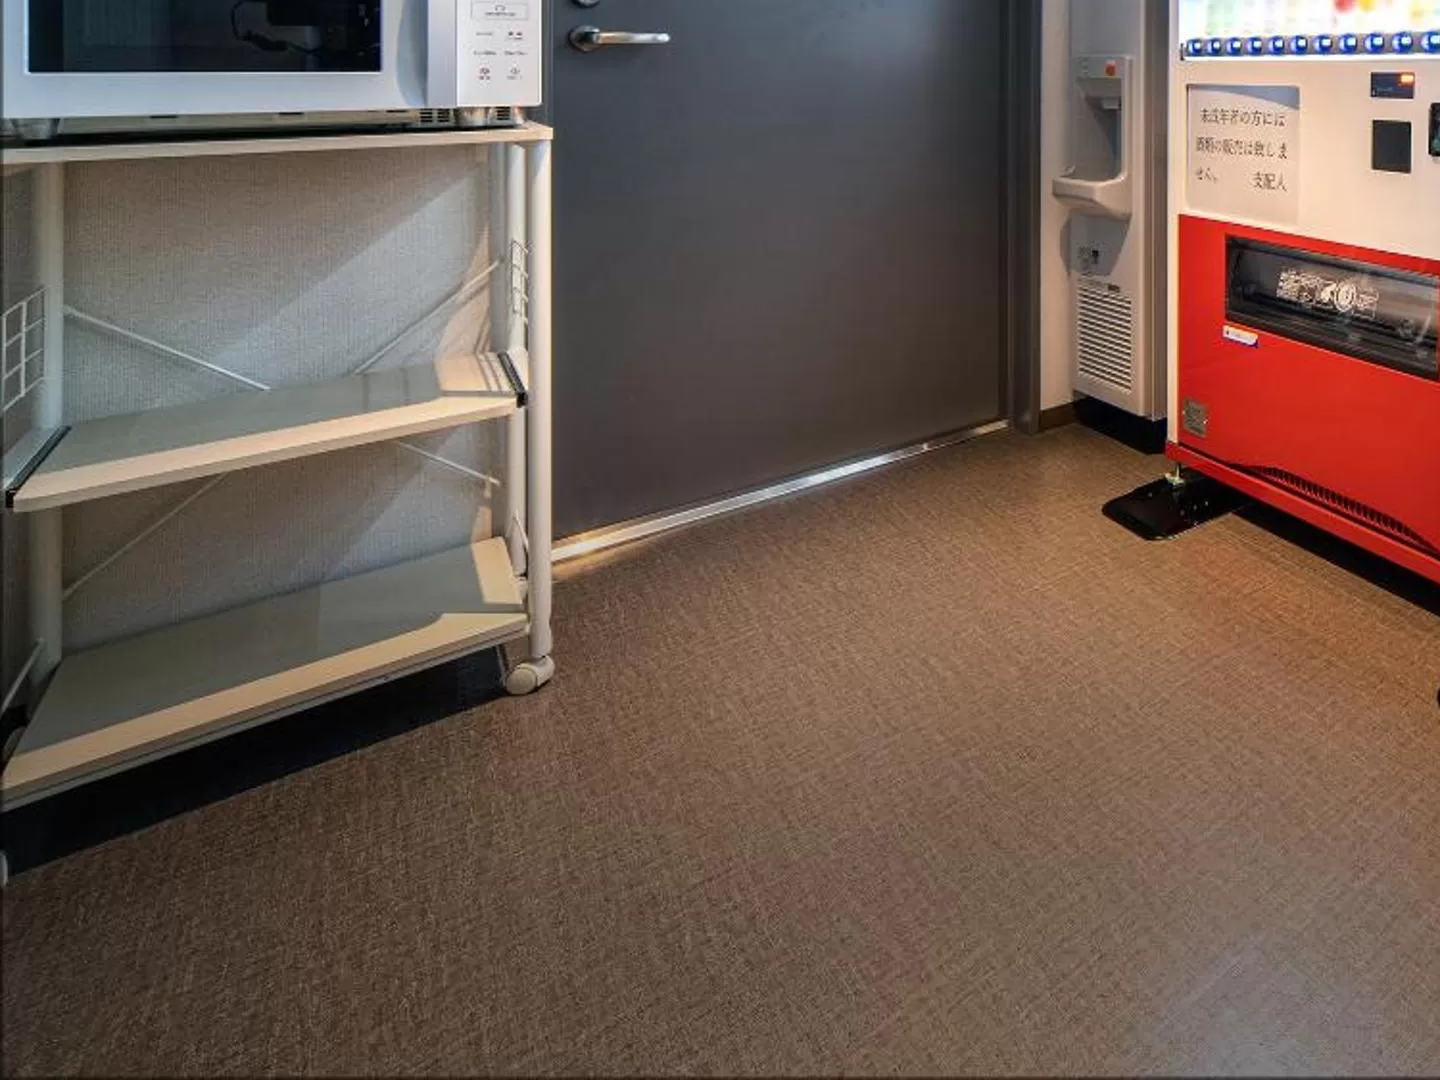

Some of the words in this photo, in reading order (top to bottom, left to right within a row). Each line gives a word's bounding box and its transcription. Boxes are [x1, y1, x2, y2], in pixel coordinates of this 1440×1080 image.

[1200, 107, 1286, 127] 未成年者の方には
[1252, 171, 1288, 192] 支配人
